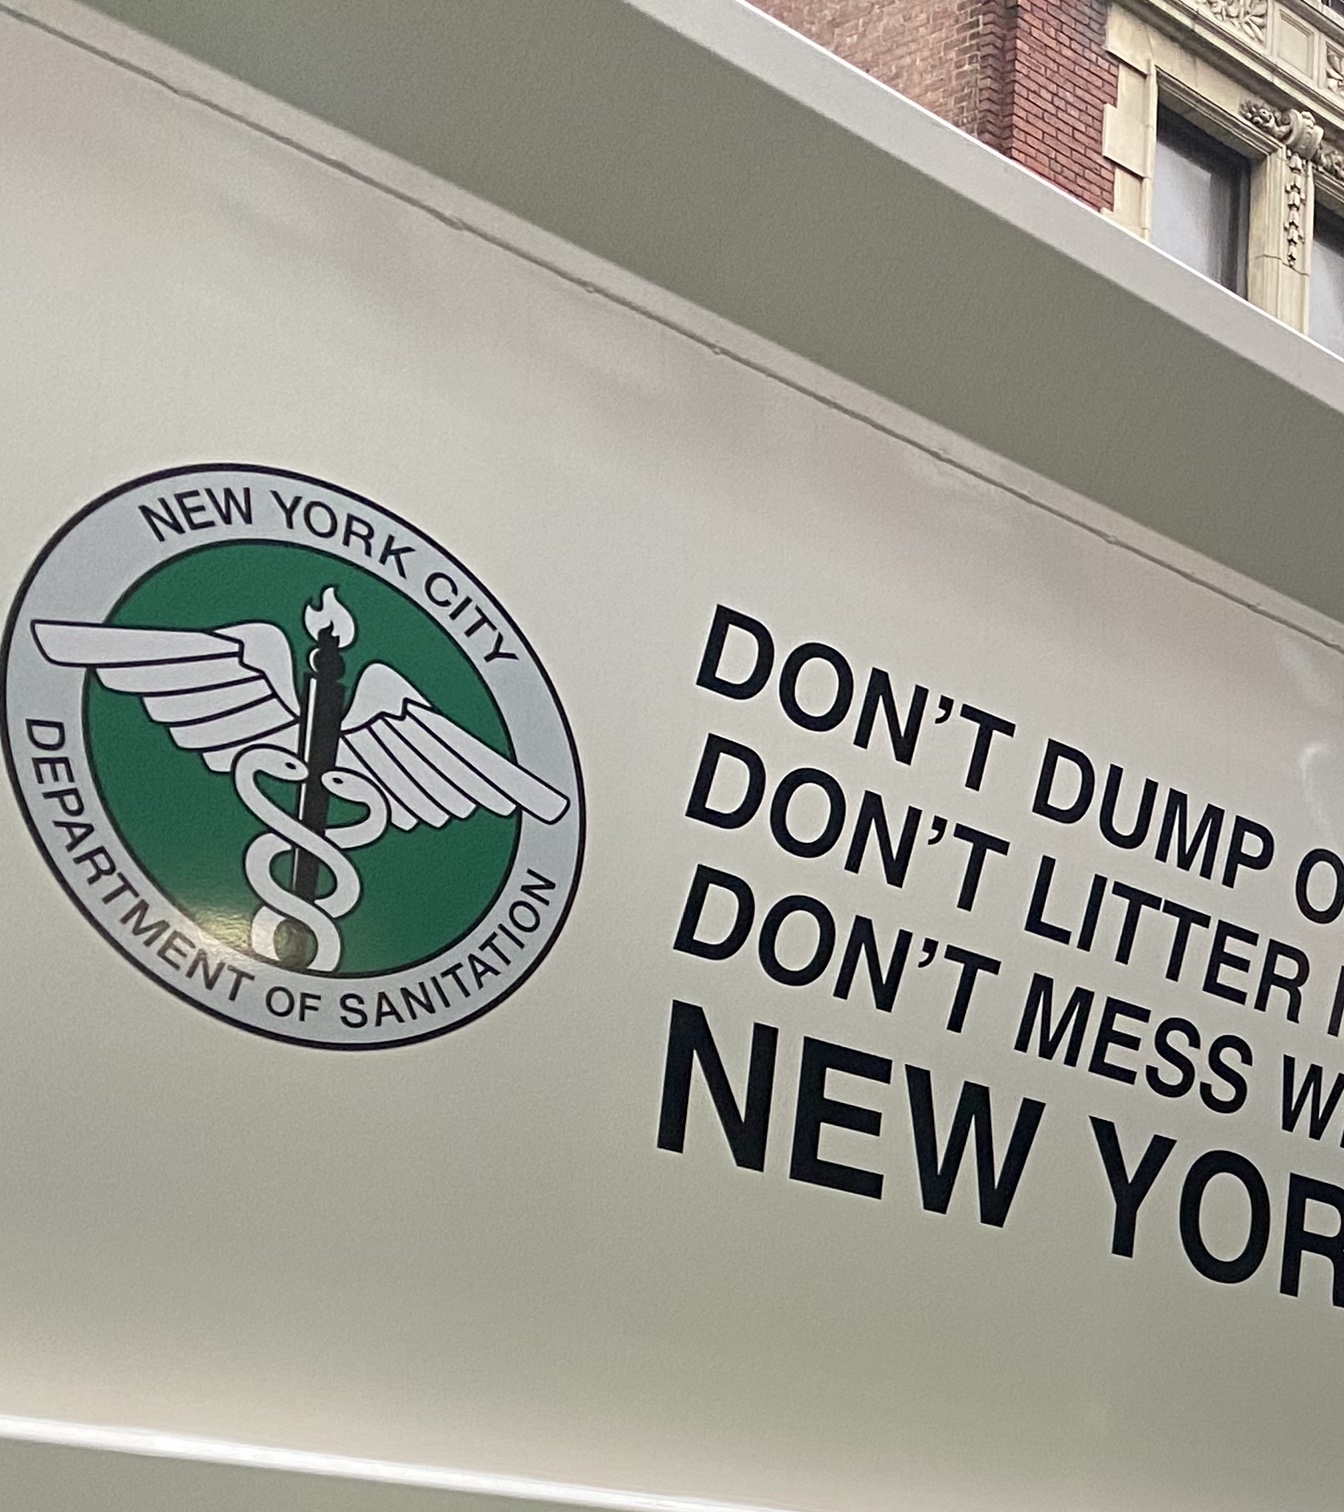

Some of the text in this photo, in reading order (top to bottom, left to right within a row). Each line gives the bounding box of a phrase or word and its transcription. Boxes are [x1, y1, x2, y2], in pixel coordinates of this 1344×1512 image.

[138, 487, 517, 667] NEW YORK CITY
[25, 717, 558, 1029] DEPARTMENT OF SANITATION
[684, 733, 1010, 914] DON'T
[1024, 854, 1310, 1025] LITTER
[695, 604, 1016, 793] DON'T
[1031, 738, 1275, 890] DUMP
[656, 1000, 1046, 1230] NEW
[672, 864, 1002, 1035] DON'T
[1013, 975, 1254, 1115] MESS
